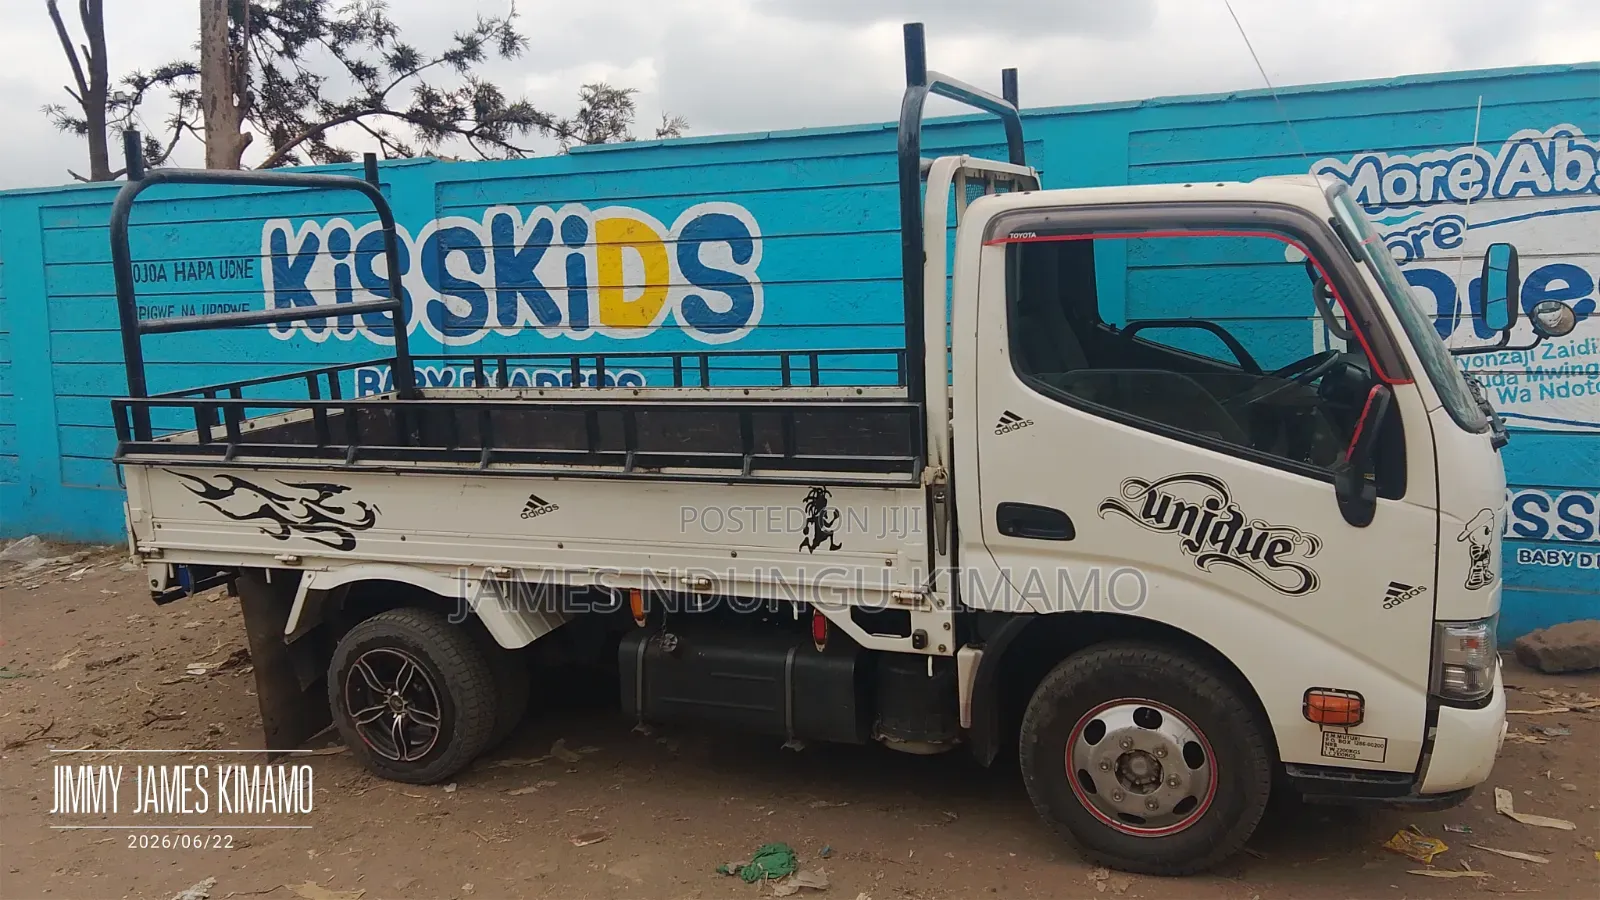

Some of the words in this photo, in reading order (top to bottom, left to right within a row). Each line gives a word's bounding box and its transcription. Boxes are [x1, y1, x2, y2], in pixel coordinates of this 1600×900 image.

[1493, 128, 1600, 199] Ab
[1009, 231, 1037, 239] TOYOTA
[1387, 218, 1465, 266] ore
[132, 262, 168, 283] OJOA
[173, 260, 216, 282] HAPA
[136, 304, 175, 320] PIGWE
[1540, 337, 1598, 361] Zaidi
[1474, 369, 1520, 388] uda
[1496, 386, 1532, 405] Wa
[994, 420, 1035, 436] adidas
[520, 503, 560, 520] adidas
[1518, 549, 1575, 566] BABY
[1382, 585, 1428, 610] adidas
